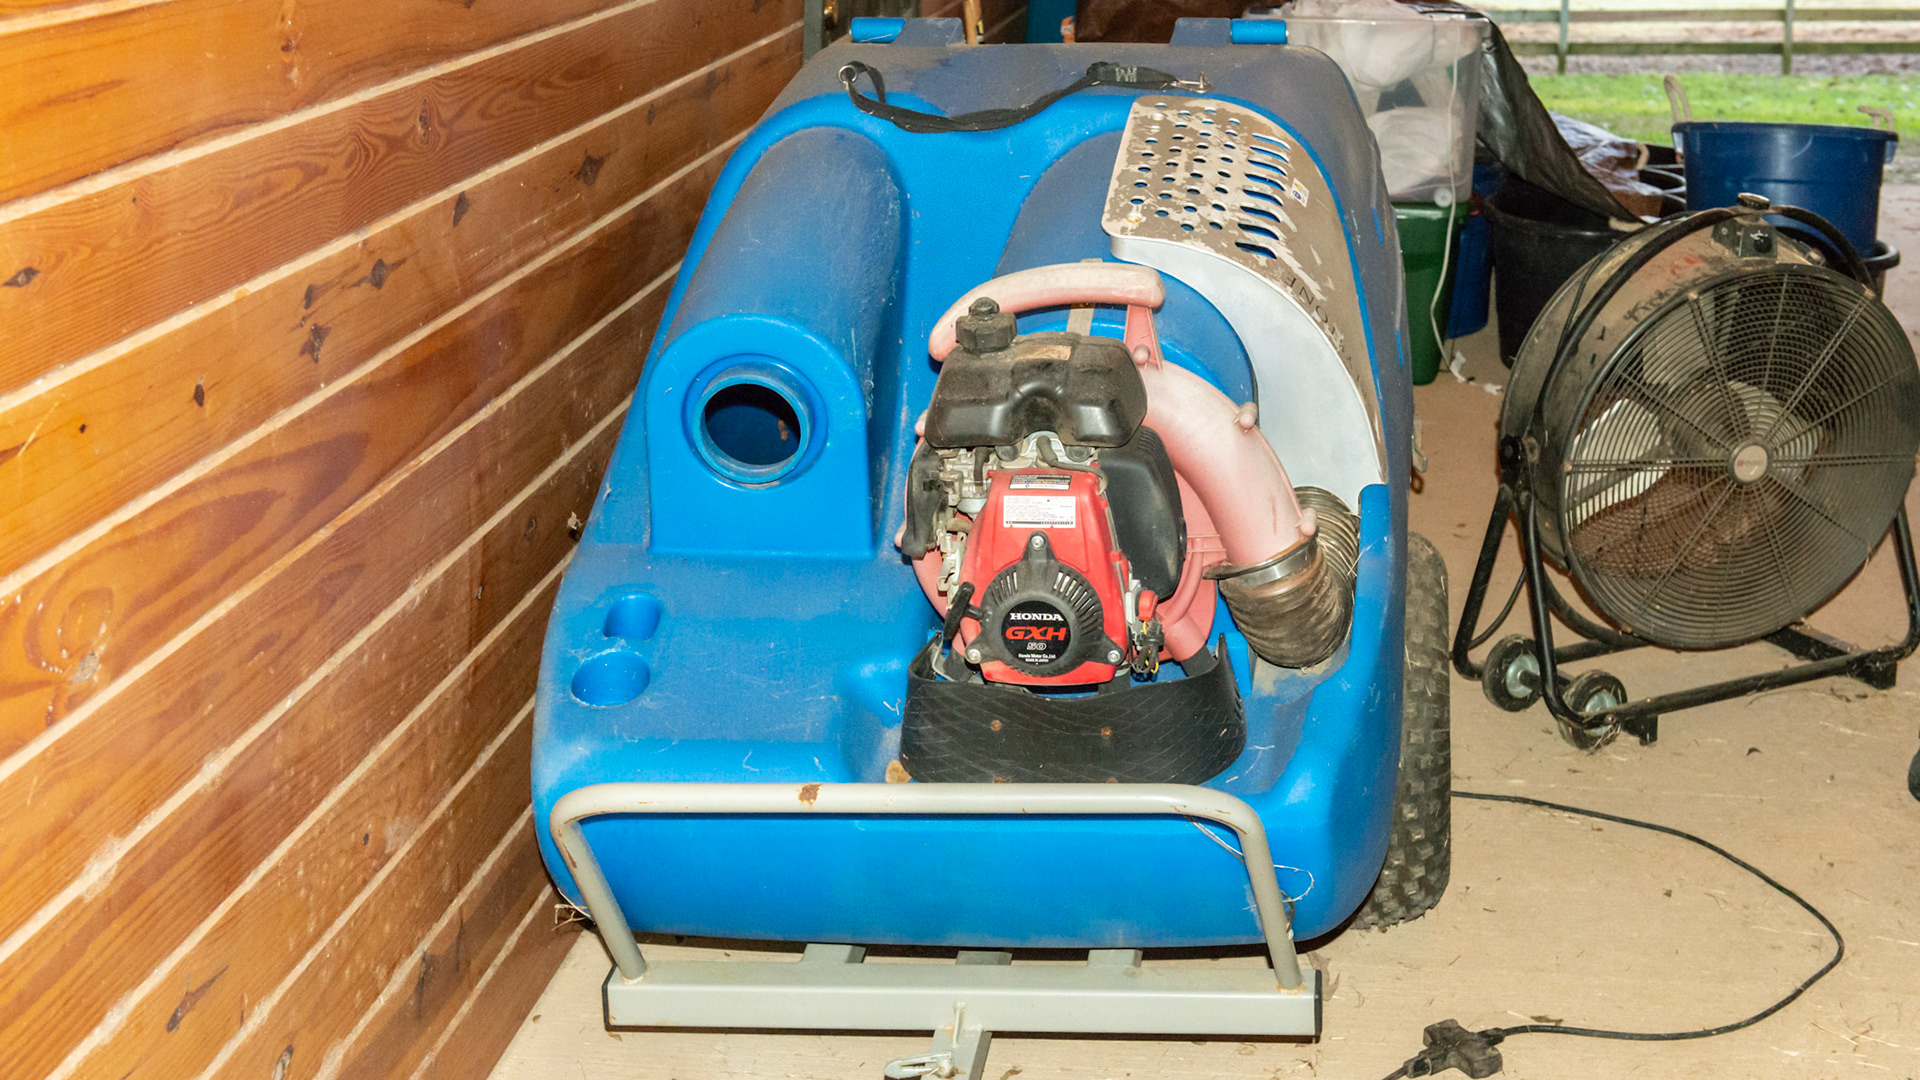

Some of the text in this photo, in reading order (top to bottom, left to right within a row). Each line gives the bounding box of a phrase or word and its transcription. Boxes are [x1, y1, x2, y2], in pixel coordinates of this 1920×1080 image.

[1010, 613, 1064, 621] HONDA
[1005, 626, 1067, 641] GXH
[1026, 642, 1047, 651] 50
